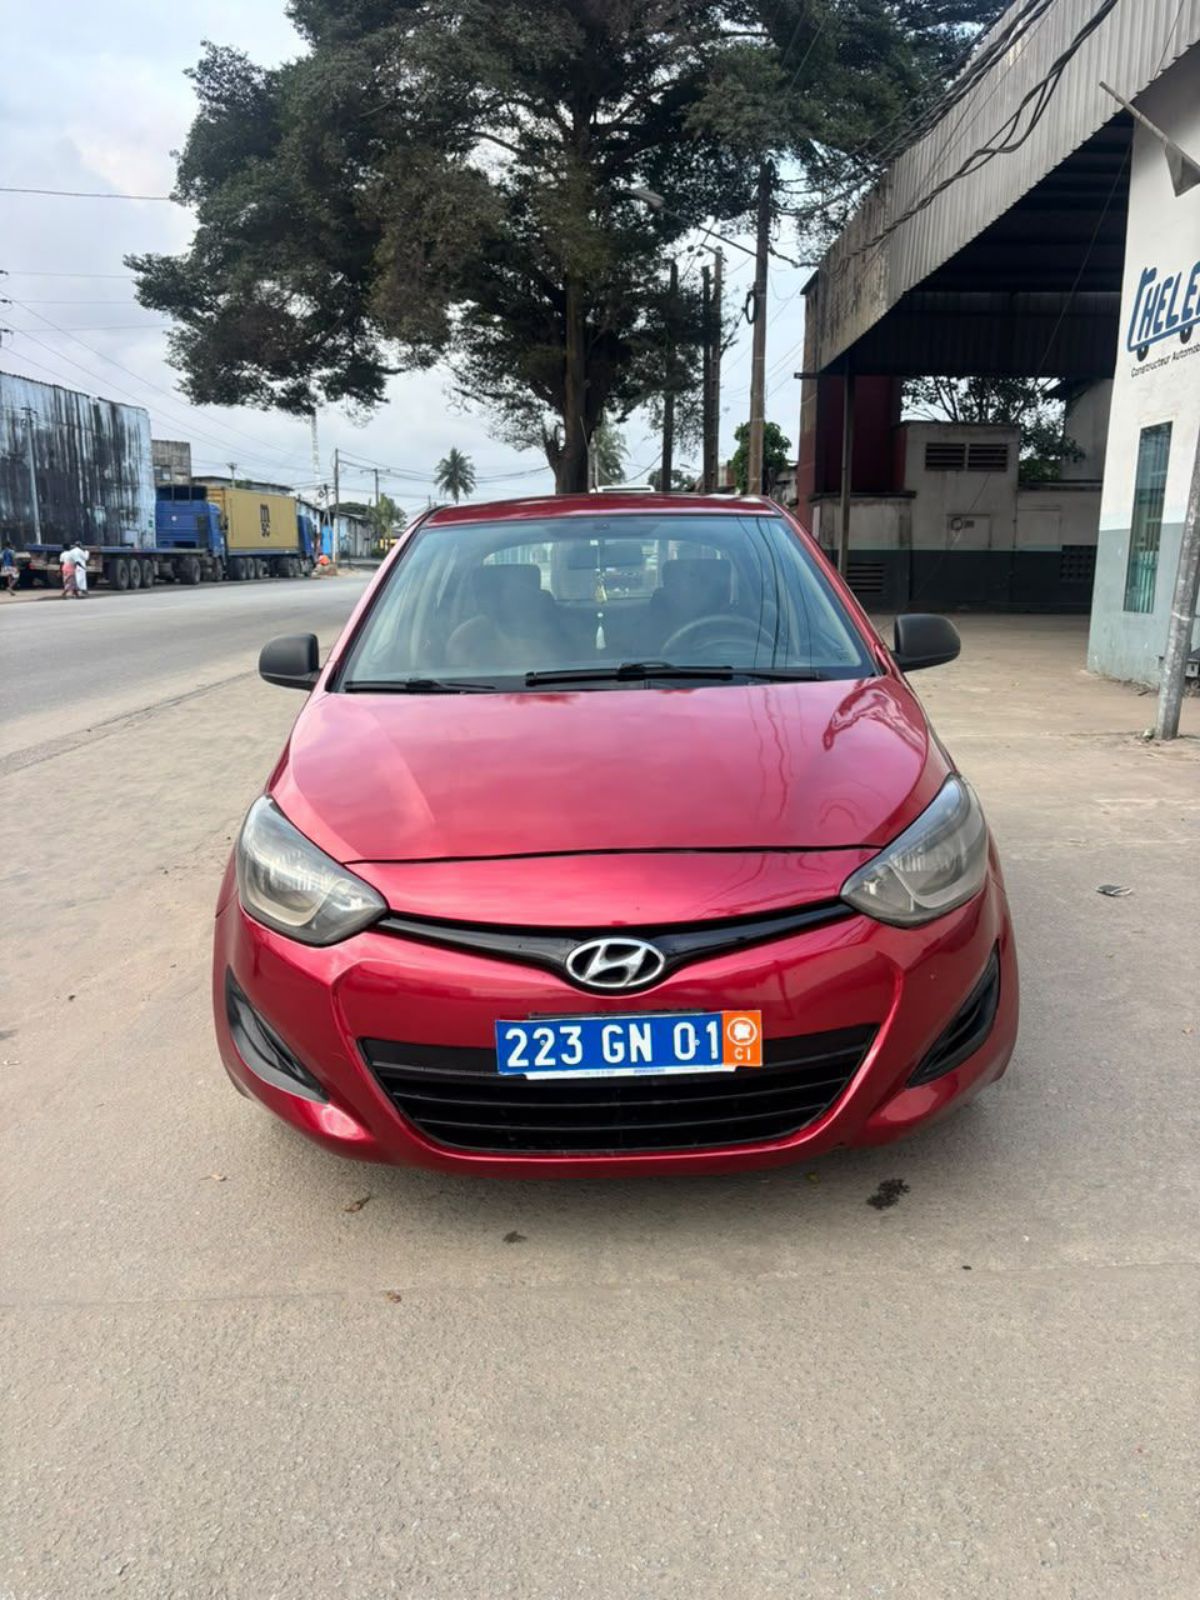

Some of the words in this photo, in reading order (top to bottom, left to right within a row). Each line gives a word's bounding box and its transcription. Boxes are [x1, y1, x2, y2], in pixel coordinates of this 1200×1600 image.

[1127, 260, 1200, 352] CHELE
[1131, 355, 1171, 378] Constructeur
[505, 1026, 583, 1068] 223
[601, 1022, 654, 1064] GN
[674, 1020, 719, 1061] 01
[734, 1047, 751, 1061] CI
